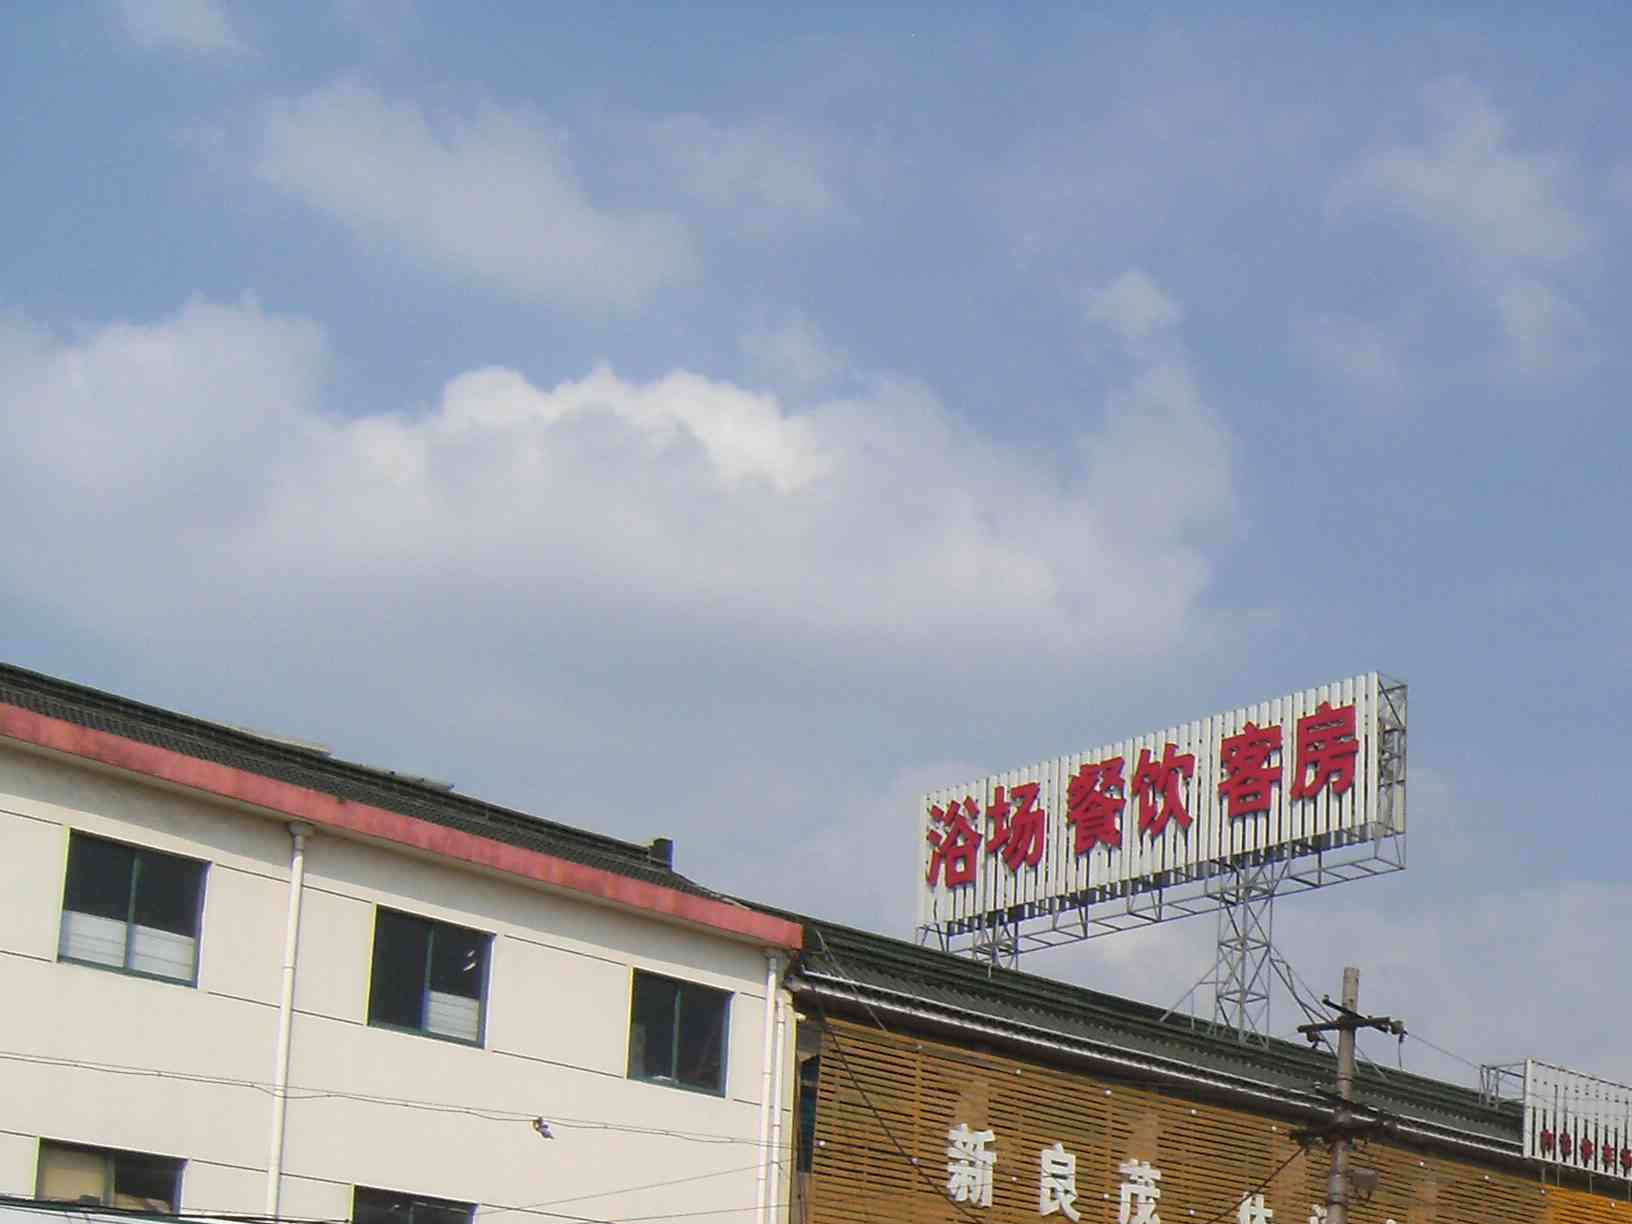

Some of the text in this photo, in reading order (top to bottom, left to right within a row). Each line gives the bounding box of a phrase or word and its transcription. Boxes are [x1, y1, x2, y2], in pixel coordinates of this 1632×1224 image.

[925, 701, 1361, 889] 浴场 餐饮 客房
